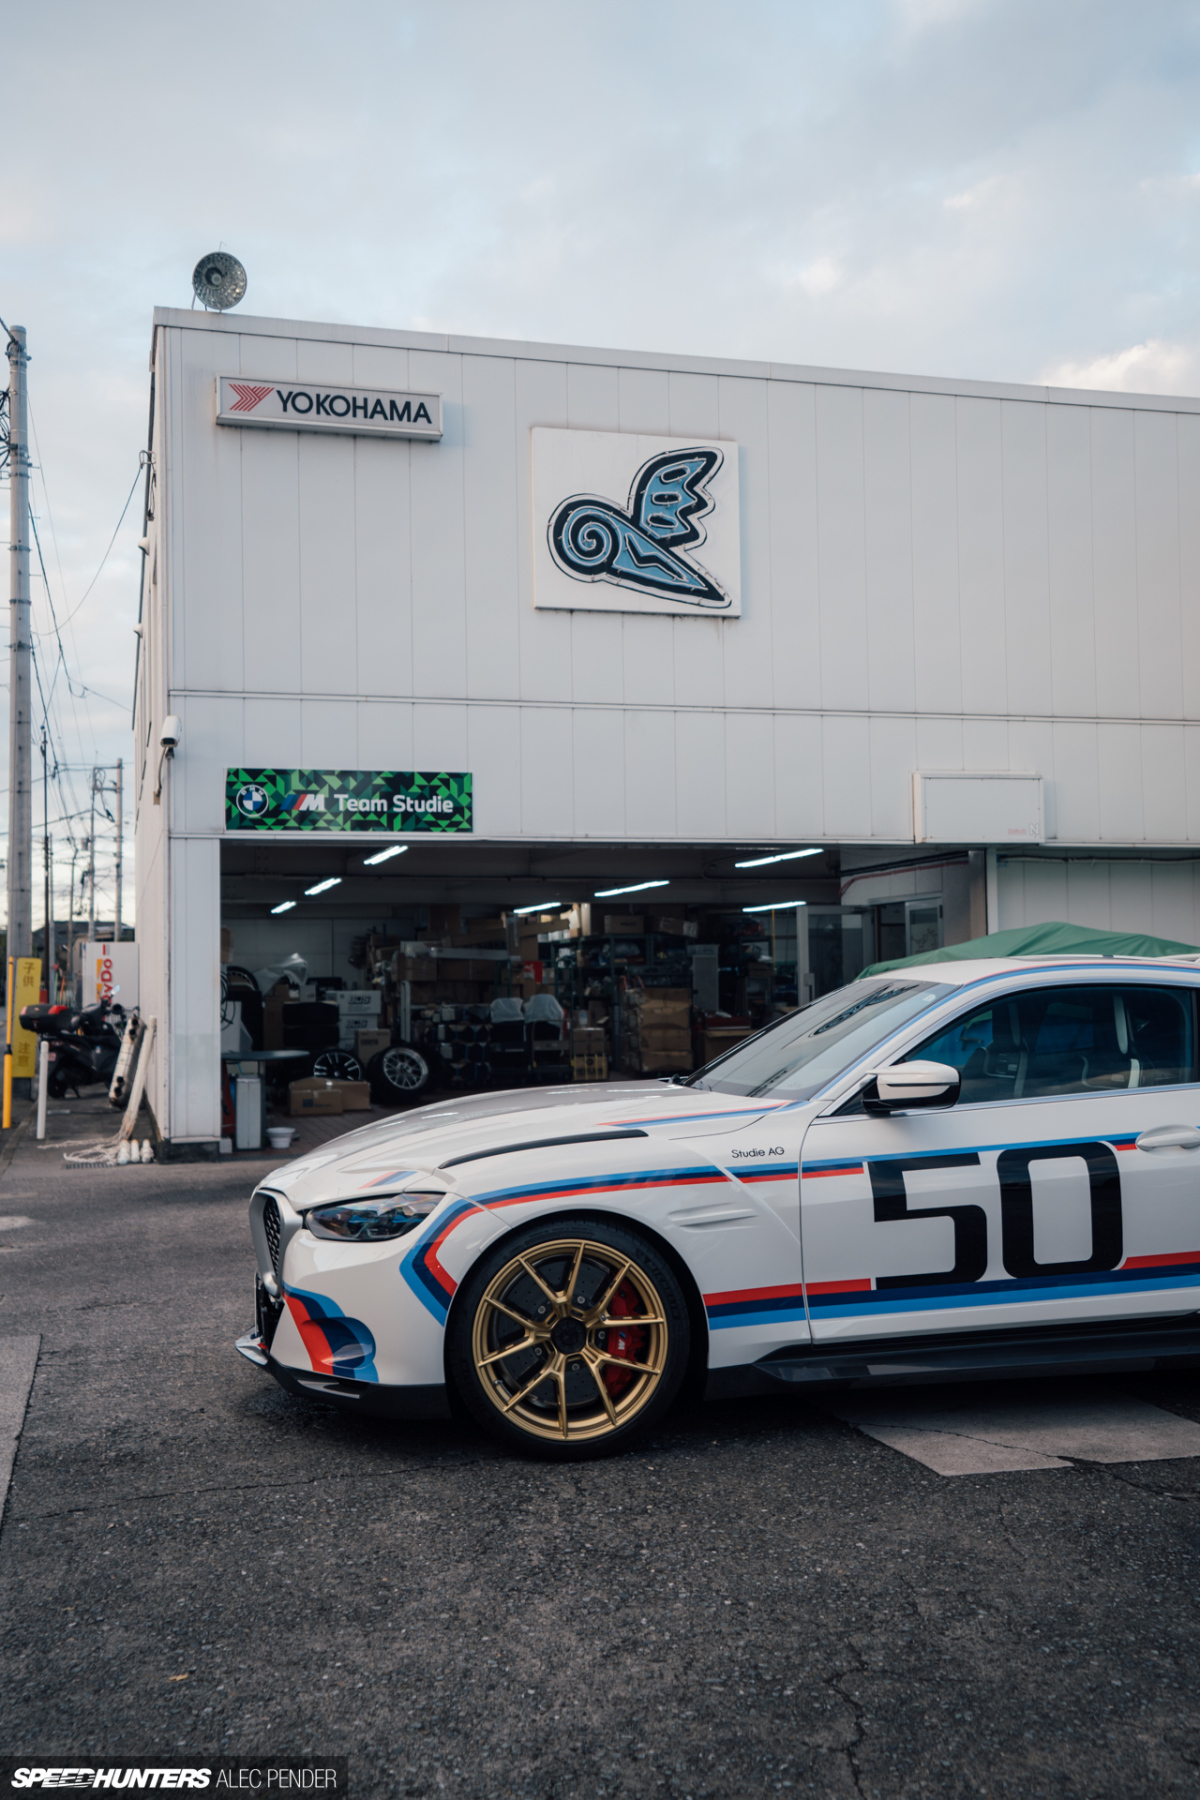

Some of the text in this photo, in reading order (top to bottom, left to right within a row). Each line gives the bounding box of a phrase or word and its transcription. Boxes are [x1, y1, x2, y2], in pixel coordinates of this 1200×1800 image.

[276, 390, 432, 424] YOKOHAMA
[334, 794, 387, 812] Team
[393, 795, 453, 813] Studie
[22, 962, 35, 987] 子供
[731, 1146, 785, 1159] Studie AG
[868, 1141, 1123, 1290] 50
